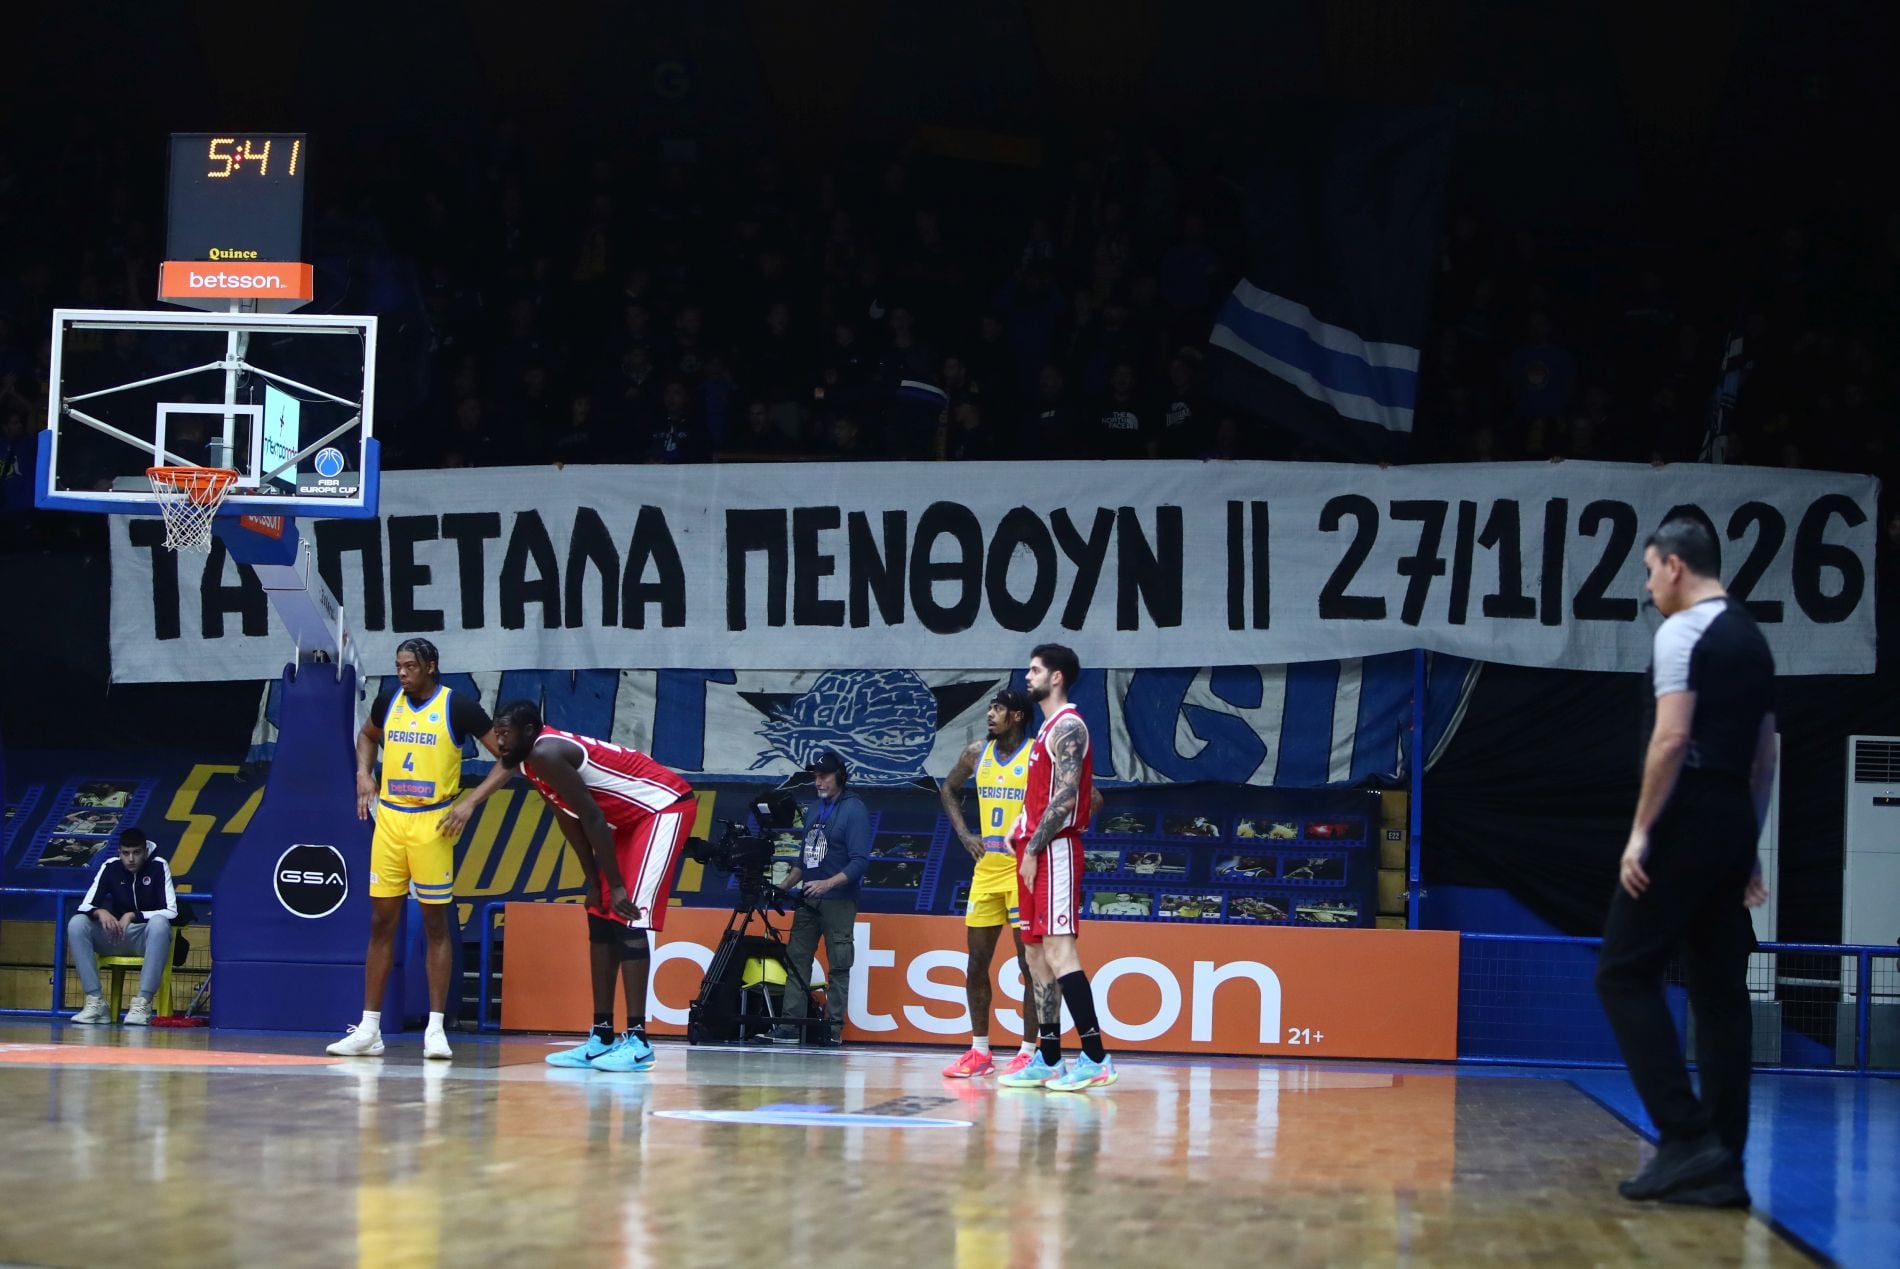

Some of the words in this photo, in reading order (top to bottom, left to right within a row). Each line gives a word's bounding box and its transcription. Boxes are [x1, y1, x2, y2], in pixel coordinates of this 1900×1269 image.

[207, 138, 300, 177] 5:41
[209, 248, 258, 260] Quince
[189, 271, 280, 289] betsson
[339, 486, 357, 494] CUP
[129, 519, 268, 640] ΤΑ
[314, 504, 686, 633] ΠΕΤΑΛΑ
[726, 501, 1183, 635] ΠΕΝΘΟΥΝ
[388, 730, 437, 745] PERISTERI
[402, 752, 415, 772] 4
[991, 807, 1004, 828] 0
[280, 870, 344, 886] GSA
[645, 922, 1281, 1043] btsson
[1287, 1027, 1325, 1045] 21+
